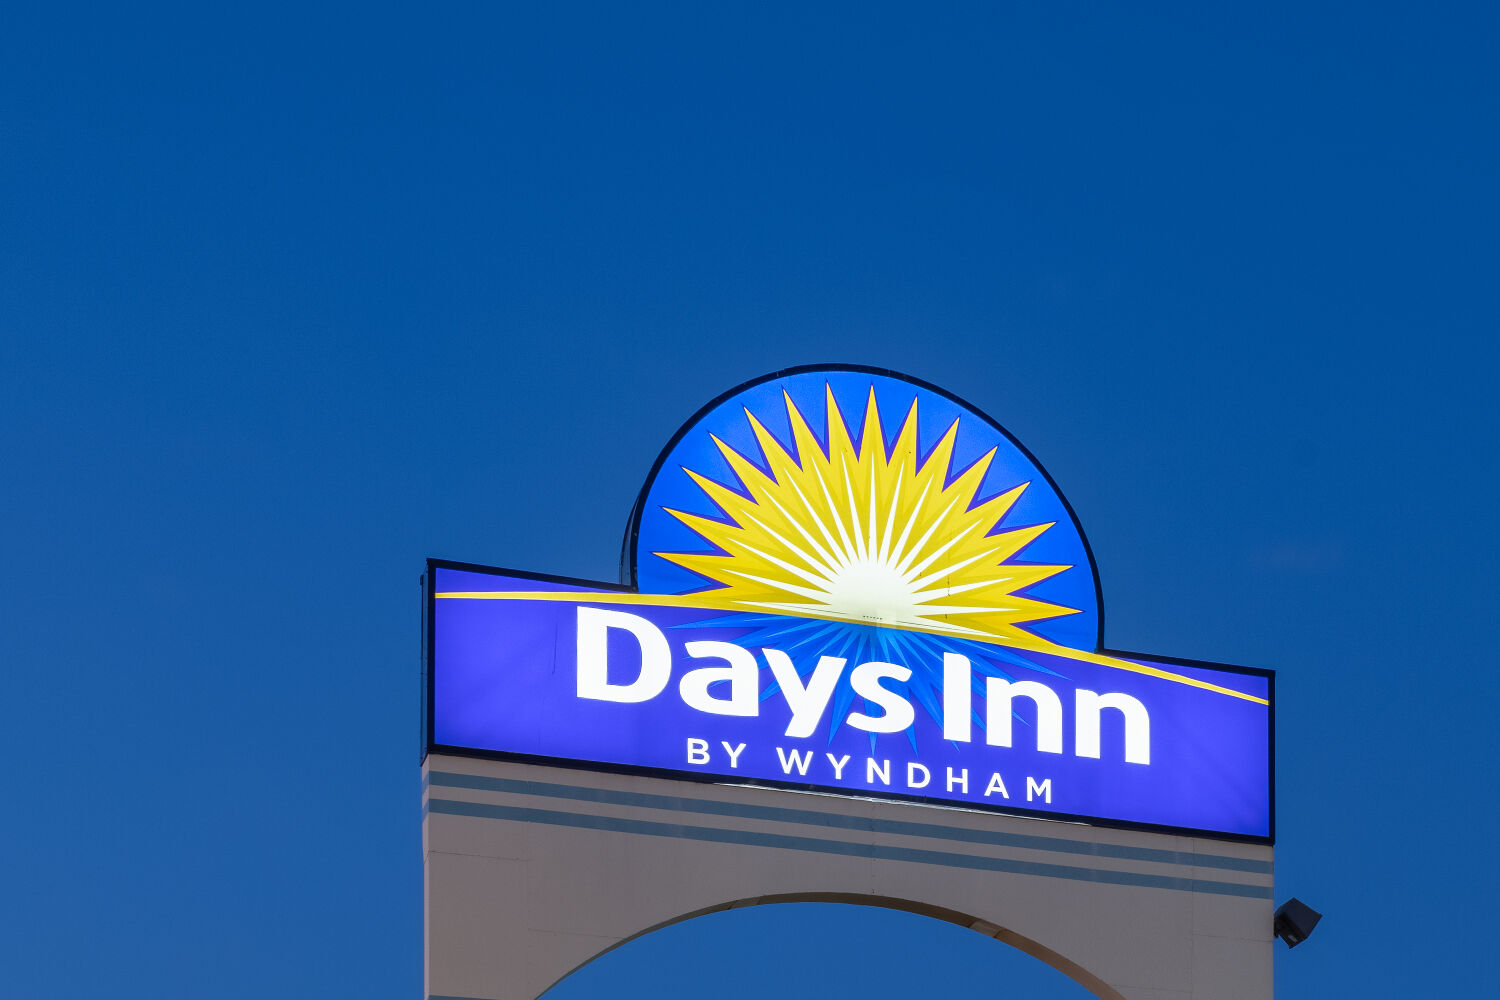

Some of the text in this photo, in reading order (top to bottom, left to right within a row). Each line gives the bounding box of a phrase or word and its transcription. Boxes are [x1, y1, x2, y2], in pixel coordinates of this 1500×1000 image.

[576, 606, 1150, 765] Days Inn
[687, 737, 1051, 804] BY WYNDHAM
